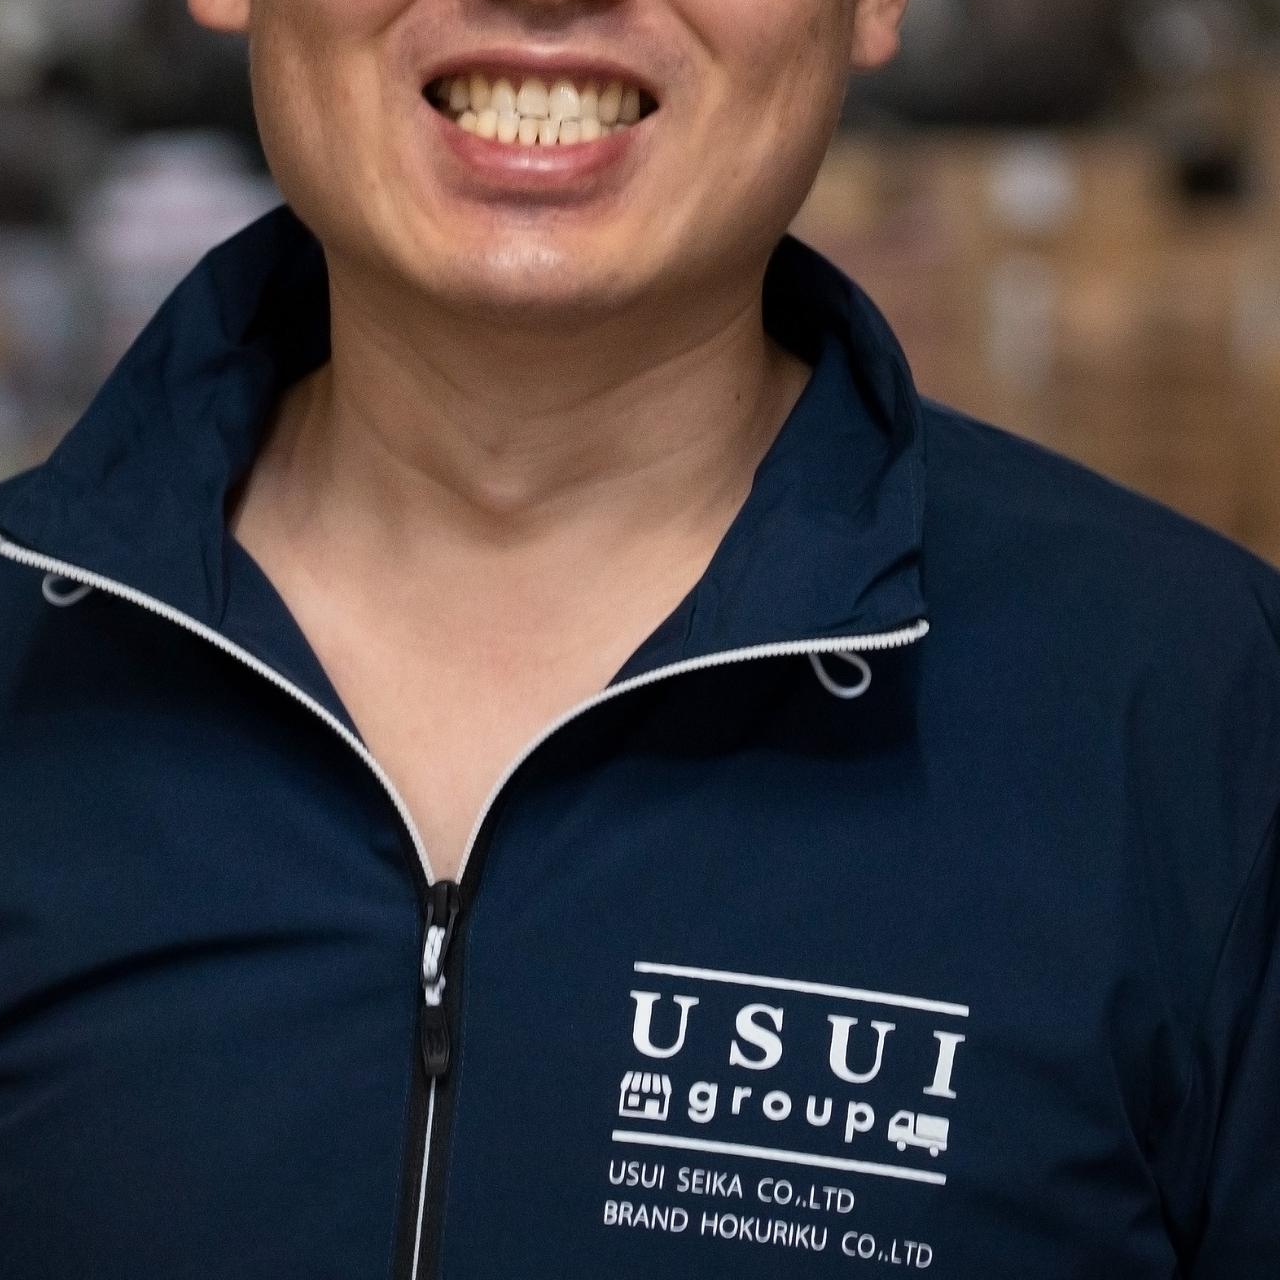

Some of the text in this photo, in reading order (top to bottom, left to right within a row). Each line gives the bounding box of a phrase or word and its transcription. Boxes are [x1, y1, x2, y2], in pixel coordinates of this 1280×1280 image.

[629, 989, 966, 1100] USUI
[687, 1080, 876, 1144] group
[608, 1159, 665, 1190] USUI
[676, 1166, 743, 1199] SEIKA
[603, 1199, 689, 1233] BRAND
[700, 1211, 828, 1252] HOKURIKU
